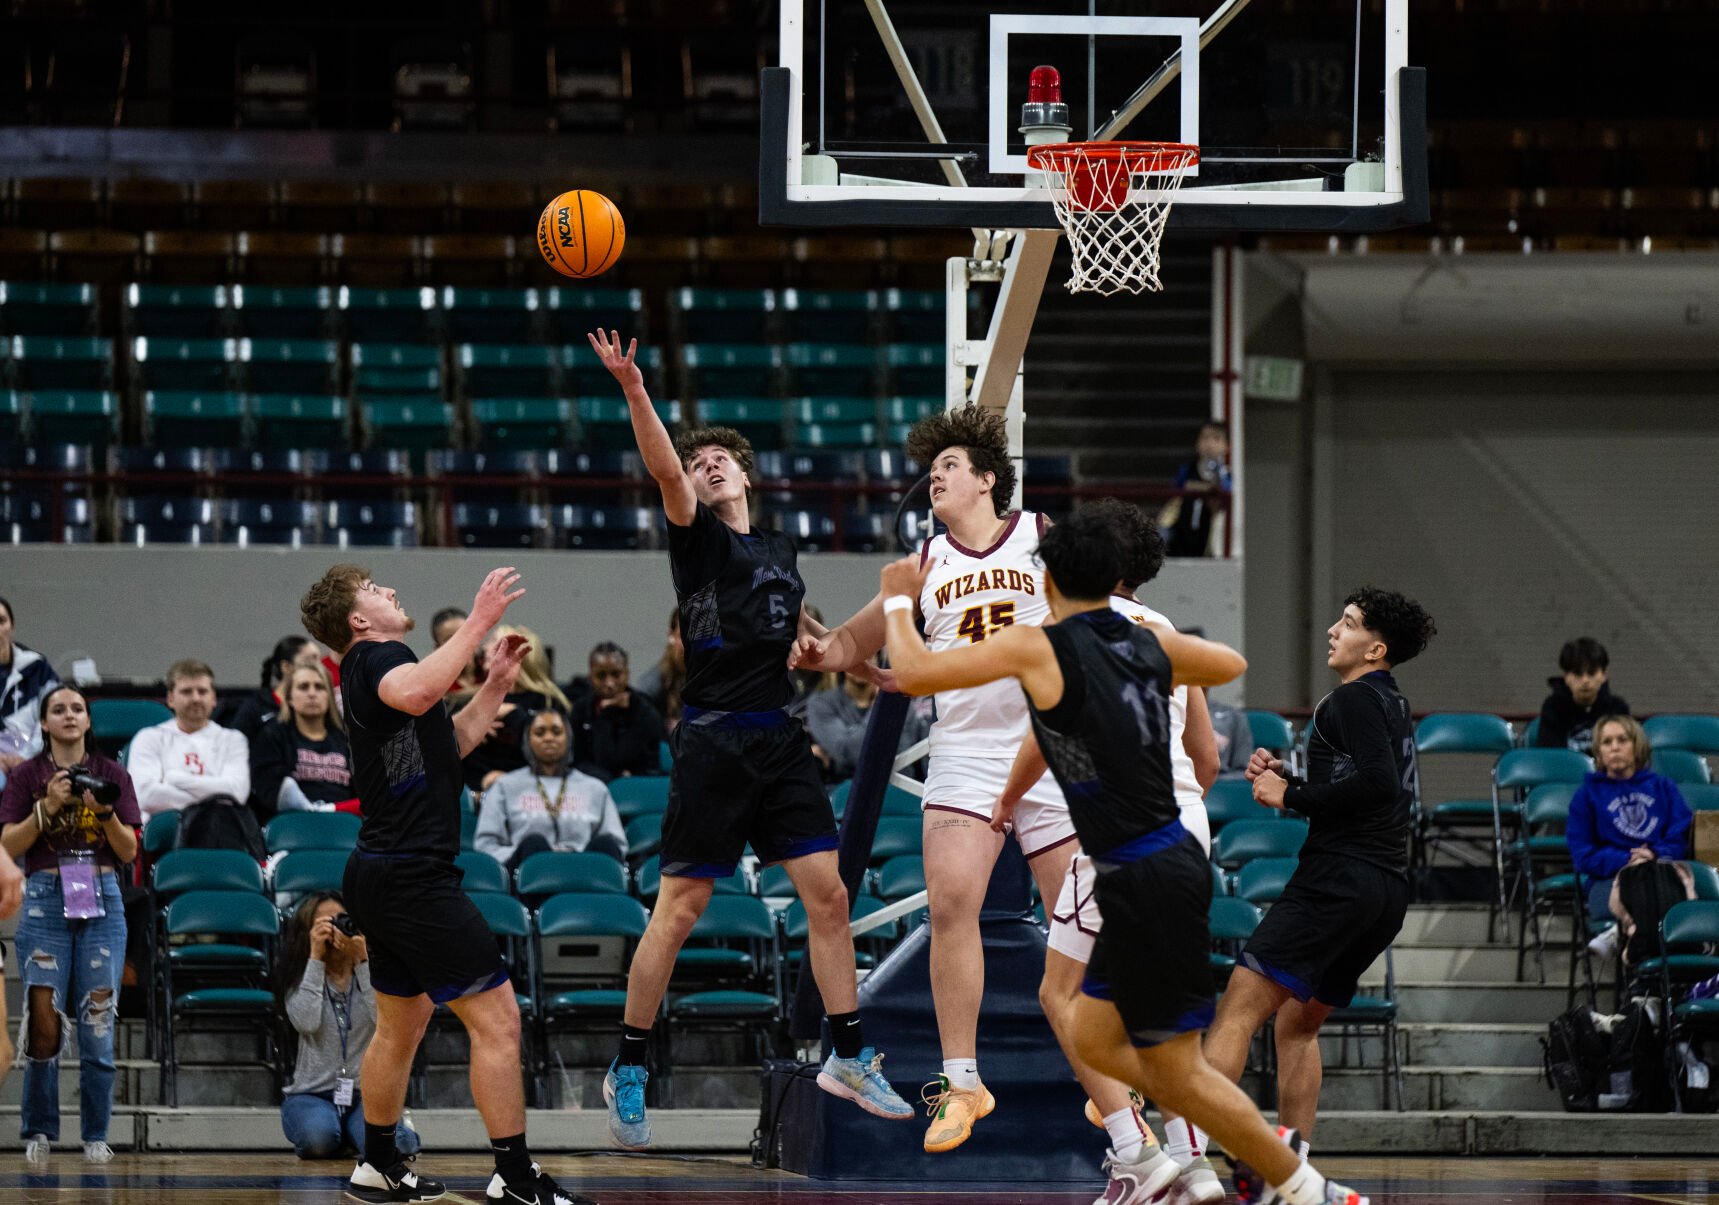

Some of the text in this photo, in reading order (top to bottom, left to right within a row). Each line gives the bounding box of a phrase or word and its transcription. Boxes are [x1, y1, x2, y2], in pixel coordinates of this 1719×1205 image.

[558, 206, 575, 249] NCAA
[934, 567, 1036, 611] WIZARDS
[768, 594, 790, 629] 5
[956, 600, 1016, 645] 45
[1121, 678, 1169, 747] 11
